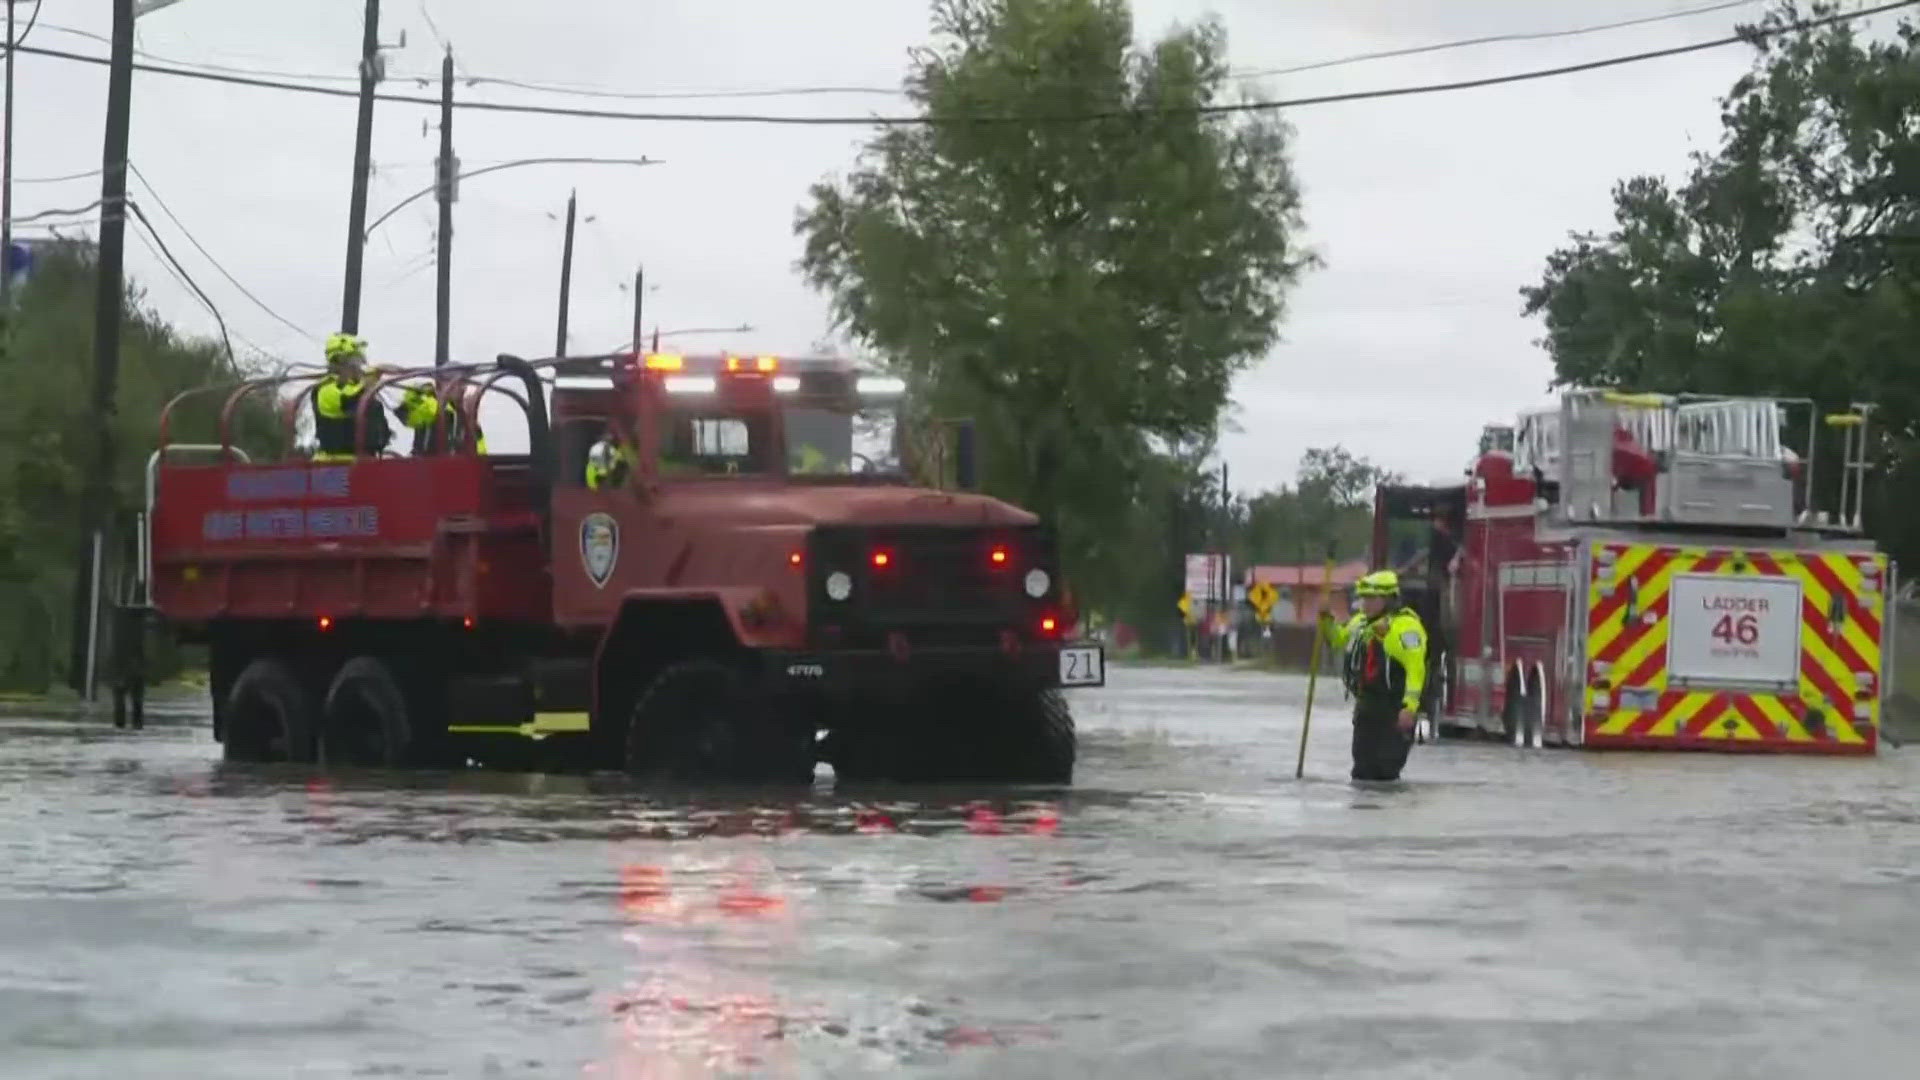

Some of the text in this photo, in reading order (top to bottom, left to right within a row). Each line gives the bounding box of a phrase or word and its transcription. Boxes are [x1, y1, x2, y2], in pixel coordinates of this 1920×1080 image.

[1703, 596, 1769, 612] LADDER
[1711, 614, 1759, 645] 46
[1065, 652, 1095, 680] 21
